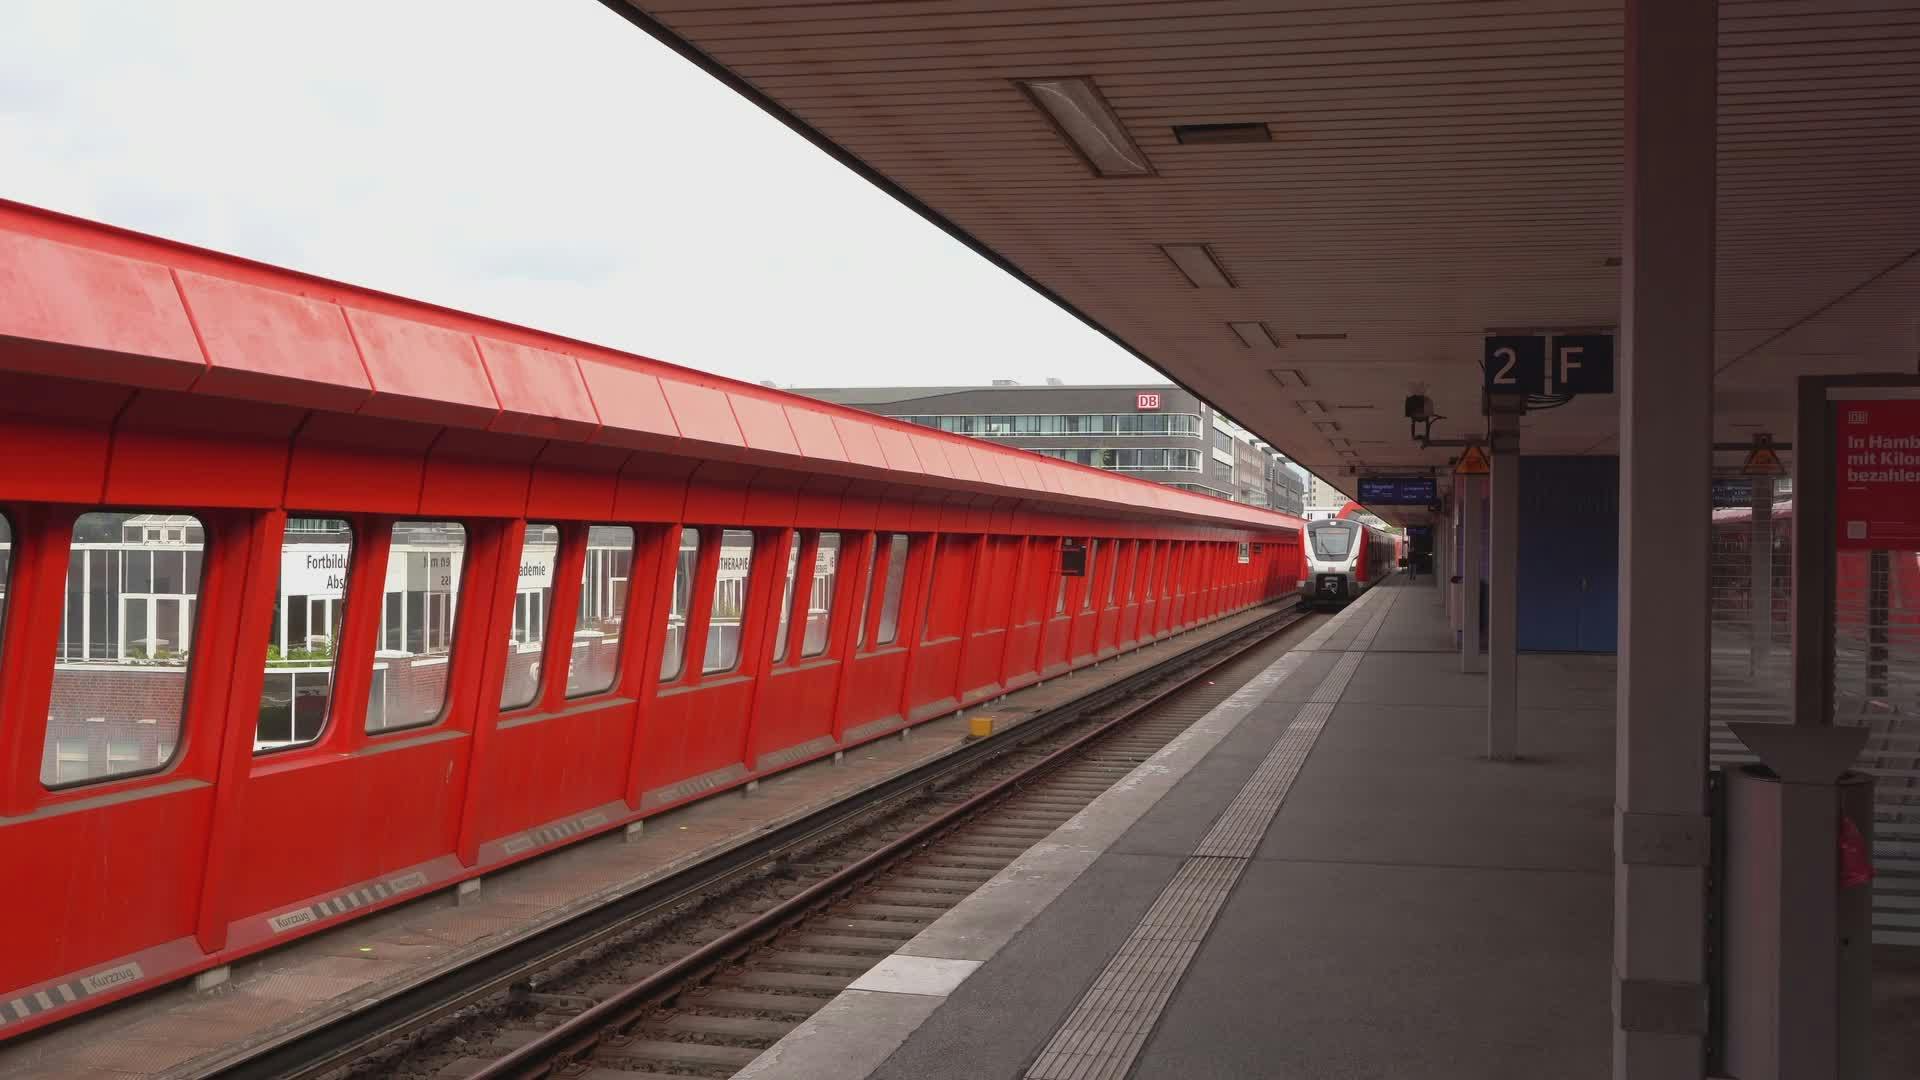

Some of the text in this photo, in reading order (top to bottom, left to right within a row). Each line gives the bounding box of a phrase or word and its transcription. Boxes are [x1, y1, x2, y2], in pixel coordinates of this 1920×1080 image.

[1493, 347, 1516, 384] 2
[1560, 347, 1584, 383] F
[1139, 395, 1157, 407] DB
[1848, 436, 1865, 448] In
[1848, 452, 1876, 464] mit
[720, 557, 748, 570] THERAPIE
[276, 911, 311, 928] Kurzzug
[89, 967, 135, 989] Kurzzug
